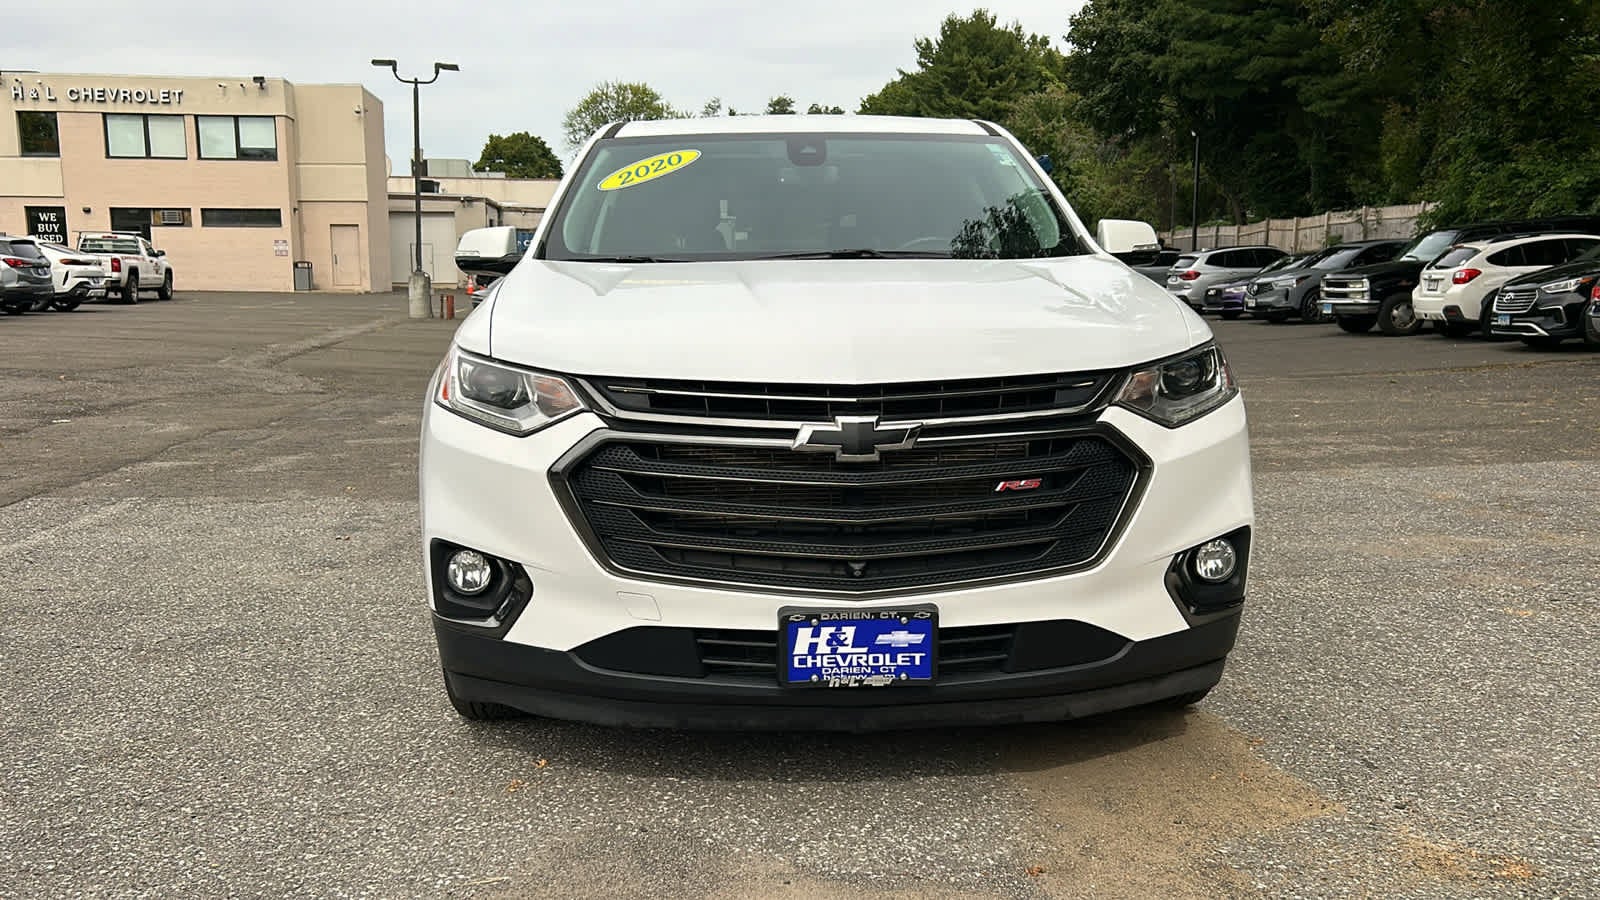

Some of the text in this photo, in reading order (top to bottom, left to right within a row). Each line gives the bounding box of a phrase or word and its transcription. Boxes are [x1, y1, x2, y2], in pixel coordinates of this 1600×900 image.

[11, 86, 184, 104] H & L CHEVROLET
[618, 154, 683, 185] 2020
[38, 212, 57, 222] WE
[37, 223, 60, 233] BUY
[994, 478, 1042, 492] RS
[792, 626, 869, 655] H&L
[793, 653, 926, 668] CHEVROLET
[822, 665, 897, 674] DARIEN, CT
